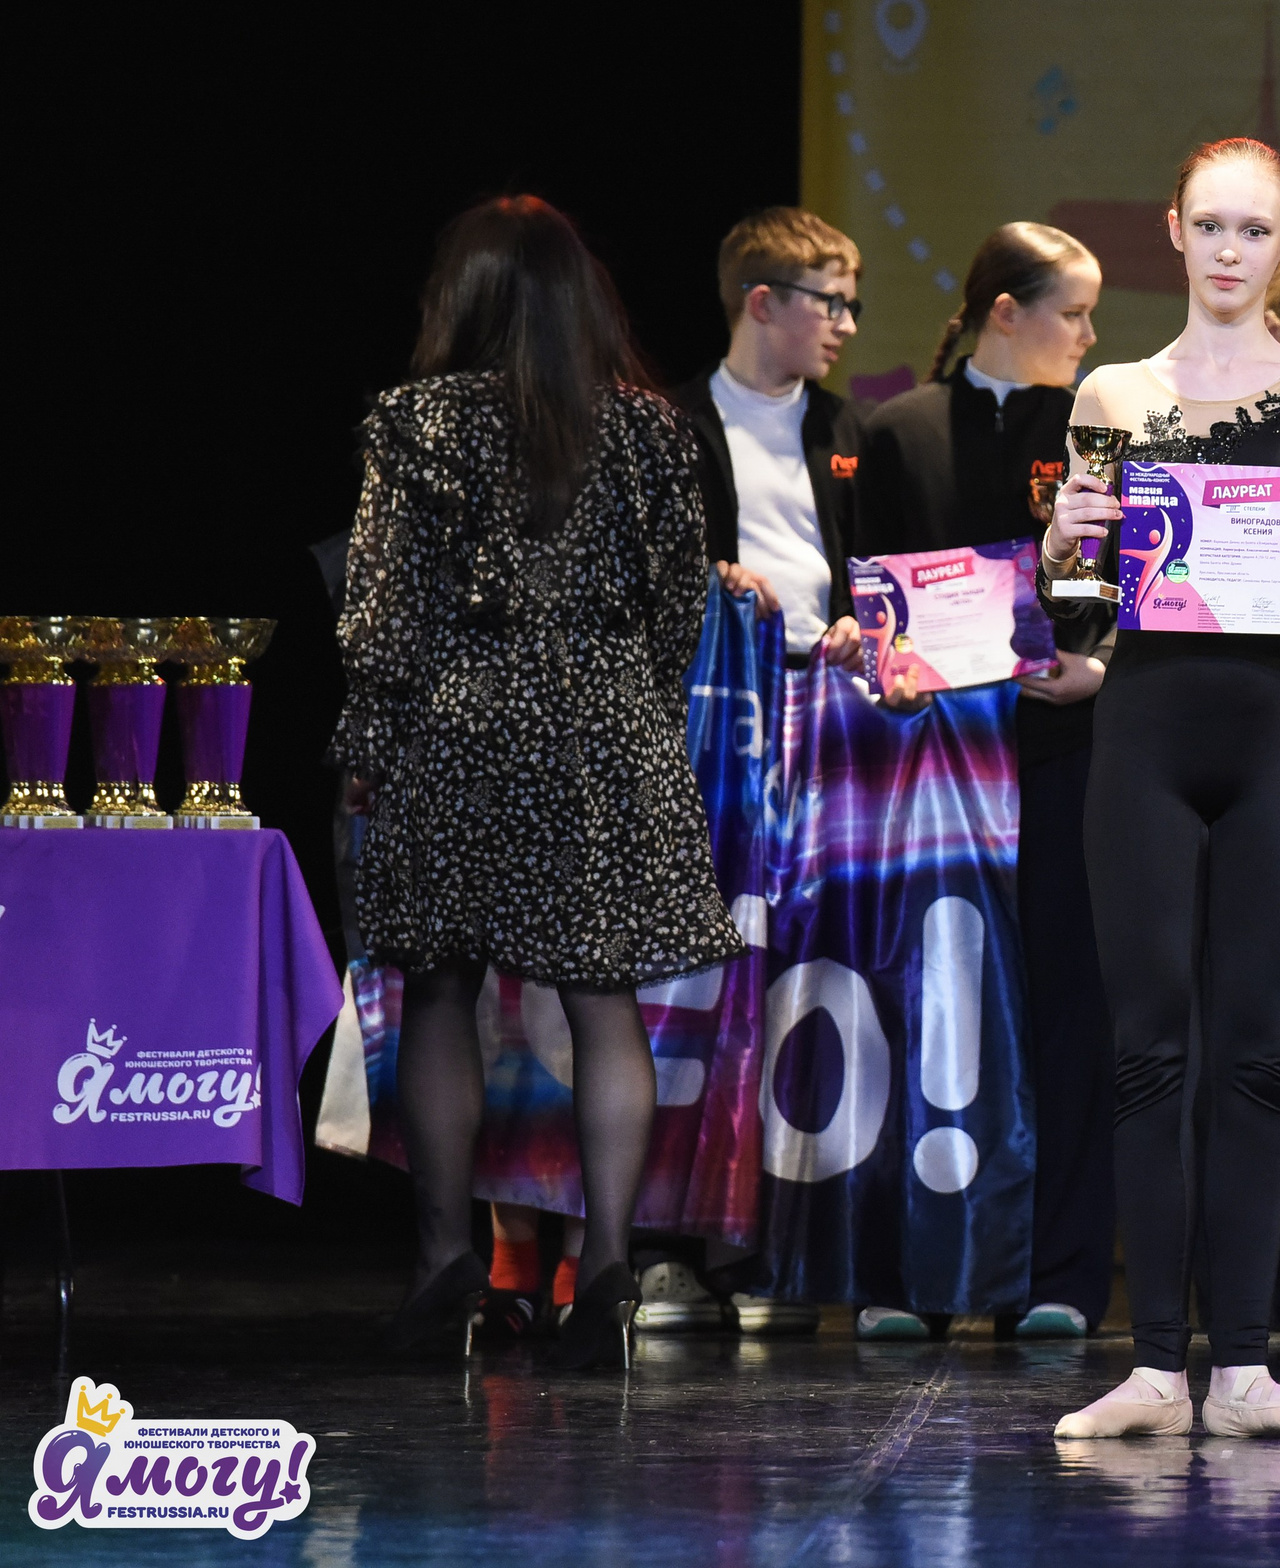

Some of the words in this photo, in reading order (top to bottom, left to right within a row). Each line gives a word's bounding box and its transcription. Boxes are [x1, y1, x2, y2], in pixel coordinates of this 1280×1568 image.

[1211, 483, 1274, 500] ЛАУРЕАТ
[1243, 527, 1273, 536] КСЕНИЯ
[916, 562, 966, 583] ЛАУРЕАТ
[137, 1050, 196, 1059] ФЕСТИВАЛИ
[197, 1047, 245, 1057] ДЕТСКОГО
[246, 1048, 253, 1056] И
[125, 1059, 192, 1069] ЮНОШЕСКОГО
[194, 1057, 253, 1067] ТВОРЧЕСТВА
[53, 1053, 115, 1124] Я
[110, 1109, 211, 1122] FESTRUSSIA.RU
